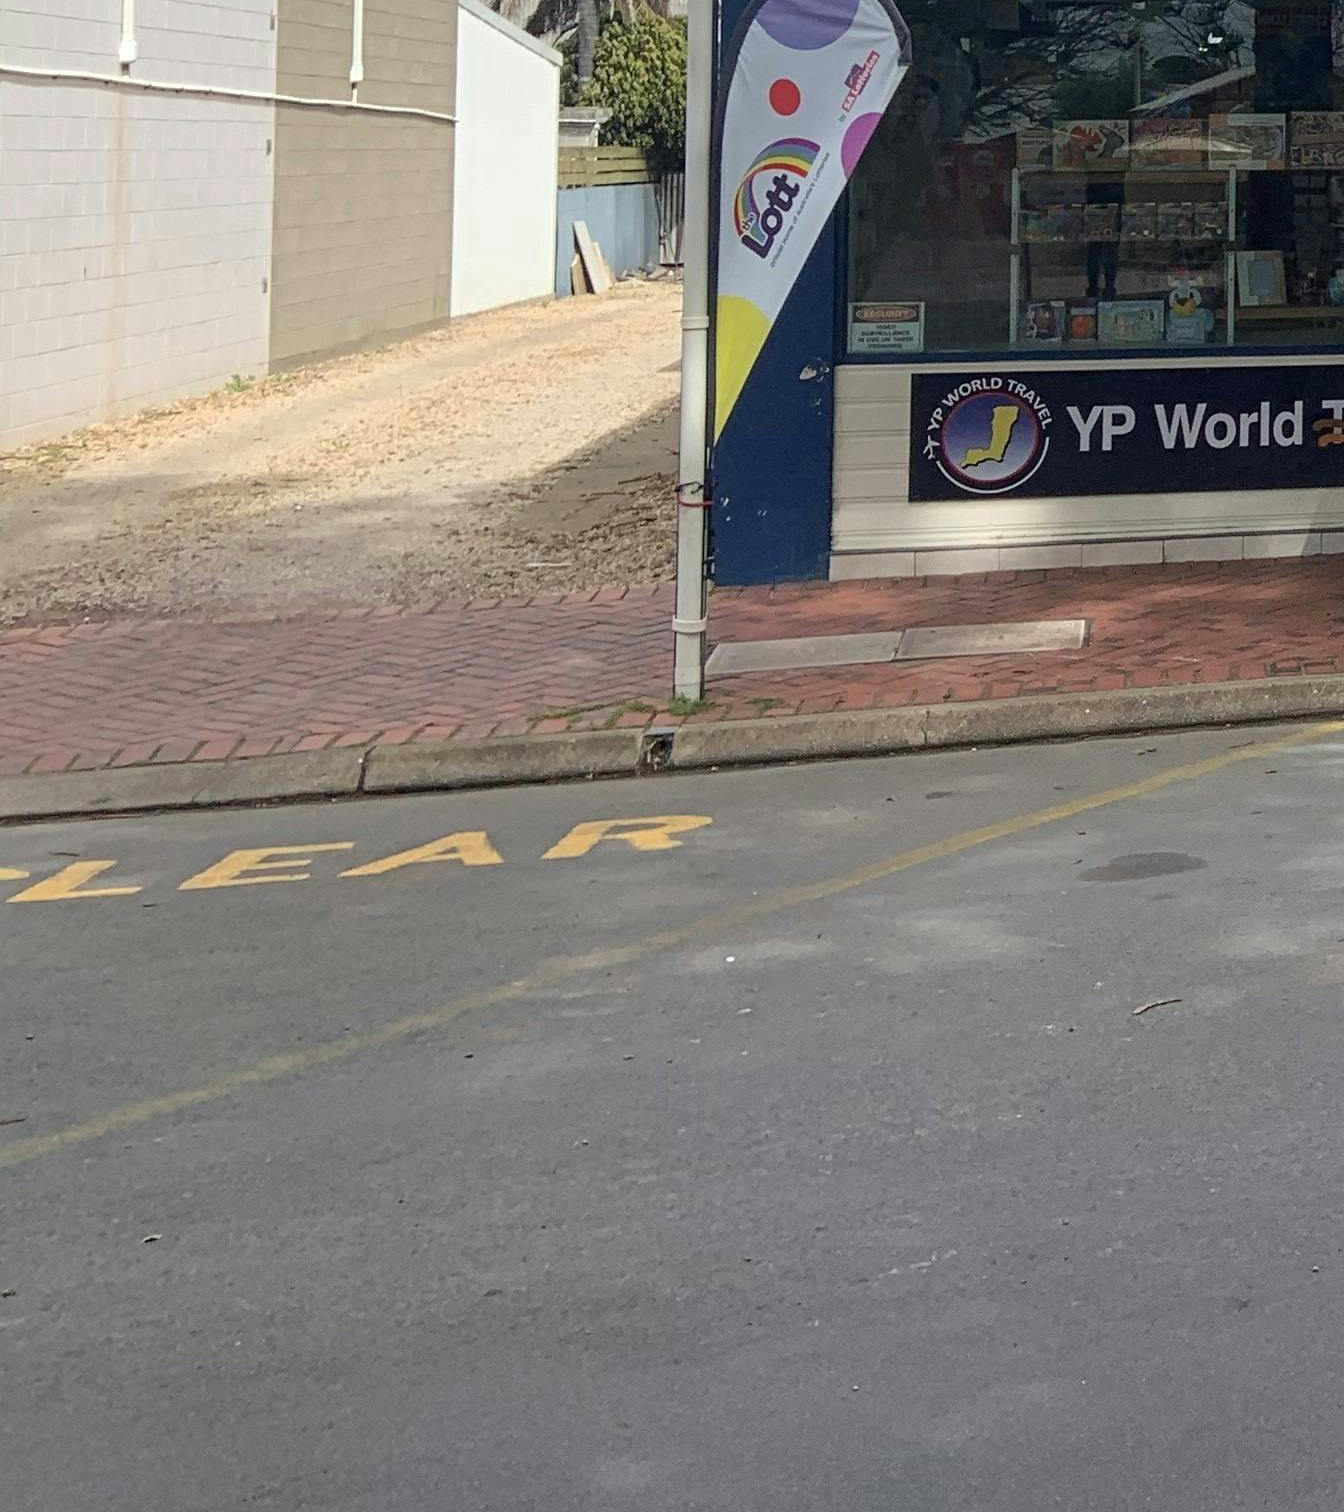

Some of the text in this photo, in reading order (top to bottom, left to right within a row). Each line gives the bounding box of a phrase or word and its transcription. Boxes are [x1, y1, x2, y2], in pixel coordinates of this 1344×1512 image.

[741, 173, 801, 260] Lott
[742, 212, 756, 232] the
[928, 375, 1053, 432] YP WORLD TRAVEL
[1066, 404, 1137, 452] YP
[1153, 399, 1303, 450] World
